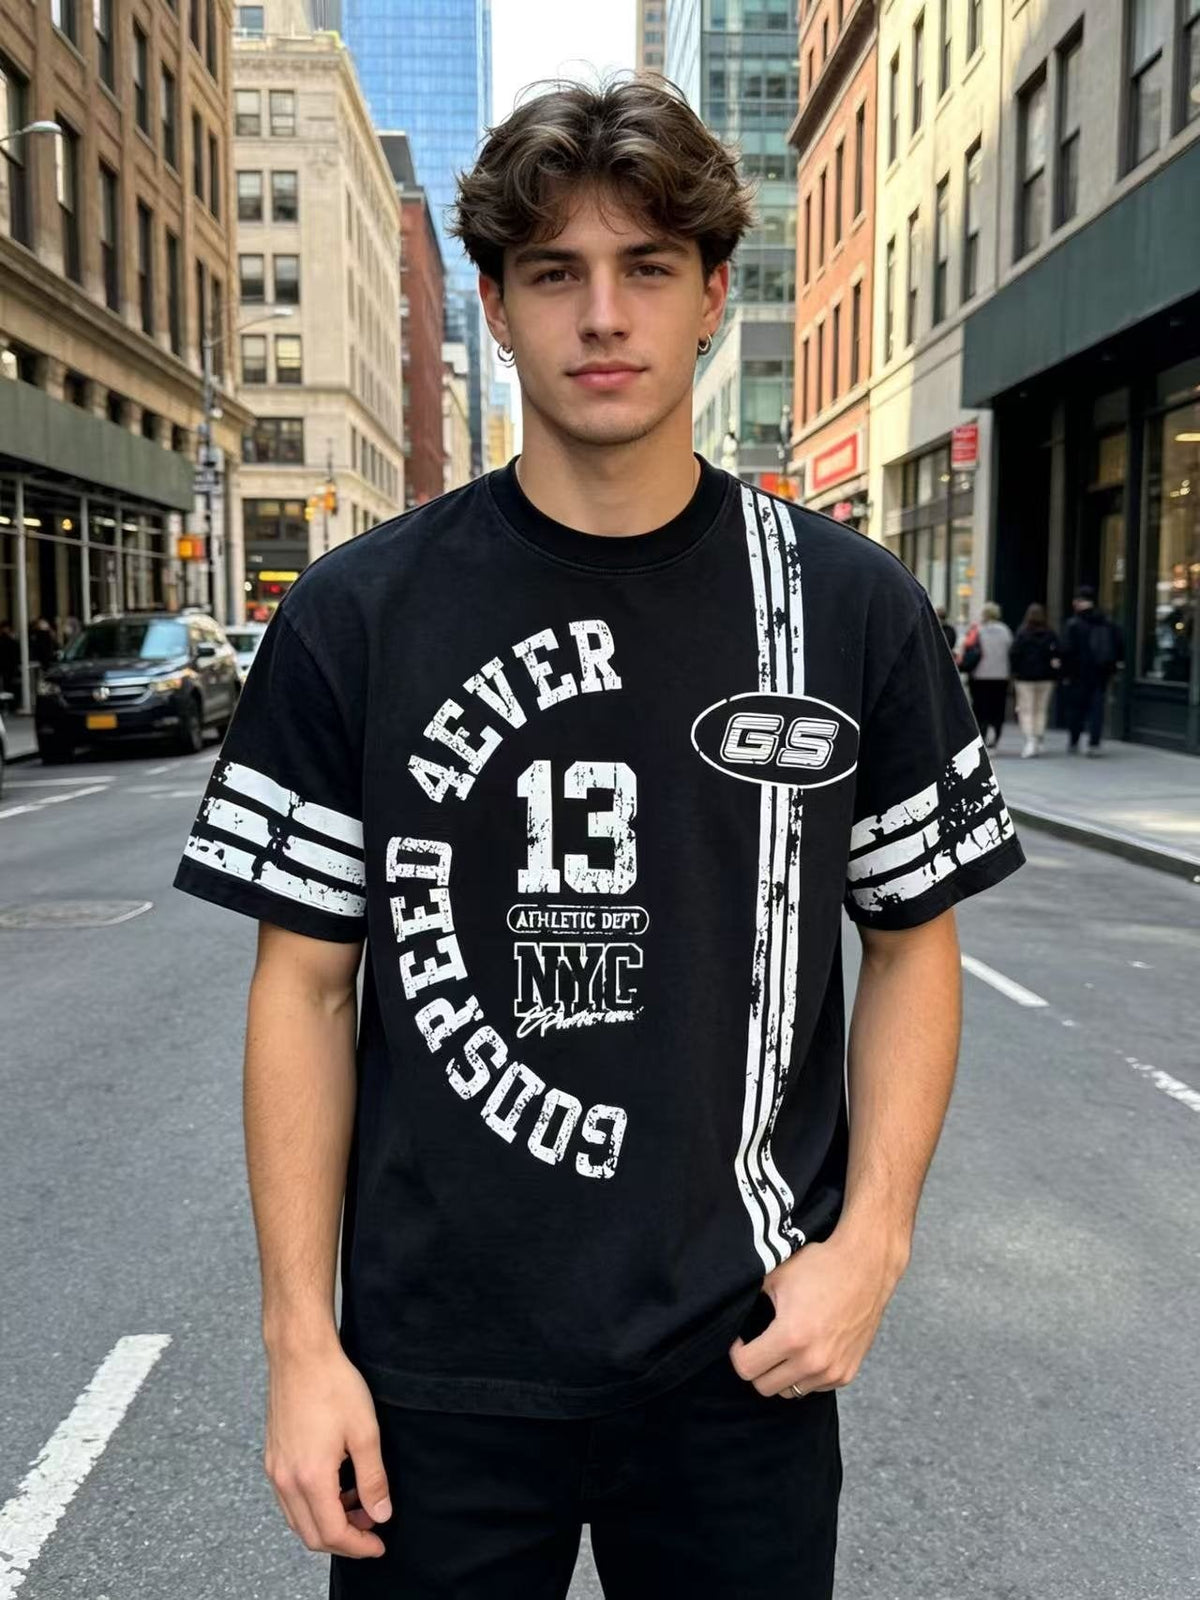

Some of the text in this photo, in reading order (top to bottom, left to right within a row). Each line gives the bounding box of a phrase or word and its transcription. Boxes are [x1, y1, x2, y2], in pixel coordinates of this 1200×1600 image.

[408, 619, 622, 803] 4EVER
[720, 712, 840, 770] GS
[516, 760, 638, 895] 13
[516, 910, 641, 929] ATHLETIC DEPT
[386, 837, 628, 1178] GODSPEED
[514, 942, 644, 1017] NYC
